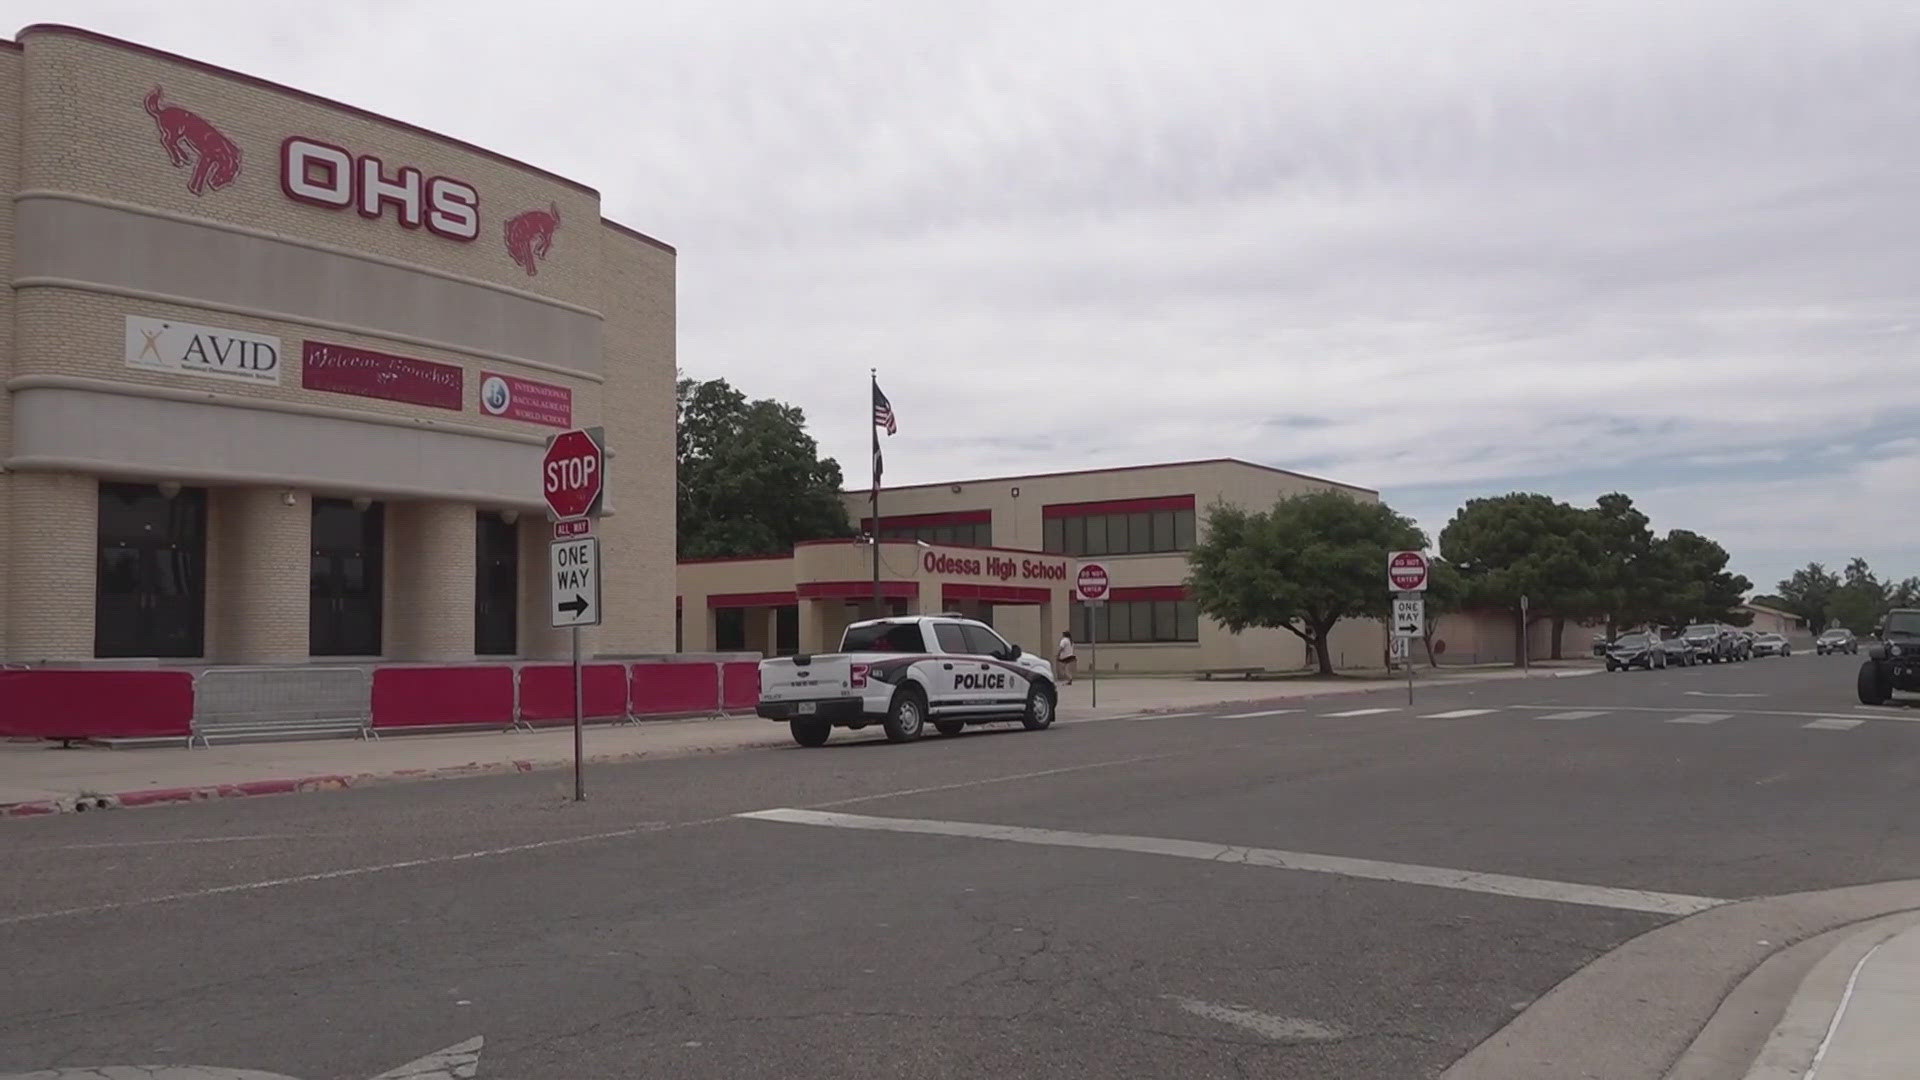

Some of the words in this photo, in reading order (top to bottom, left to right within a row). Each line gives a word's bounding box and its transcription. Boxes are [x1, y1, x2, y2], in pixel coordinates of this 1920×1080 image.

[281, 136, 479, 242] OHS
[181, 334, 277, 371] AVID
[514, 383, 569, 400] INTERNATIONAL
[514, 409, 541, 420] WORLD
[542, 413, 568, 425] SCHOOL
[547, 455, 596, 493] STOP
[558, 523, 570, 535] ALL
[573, 522, 587, 534] WAY
[558, 545, 588, 567] ONE
[924, 551, 981, 575] Odessa
[986, 556, 1017, 581] High
[1022, 559, 1066, 580] School
[557, 568, 590, 590] WAY
[1398, 602, 1418, 611] ONE
[1398, 613, 1419, 621] WAY
[954, 674, 1005, 689] POLICE
